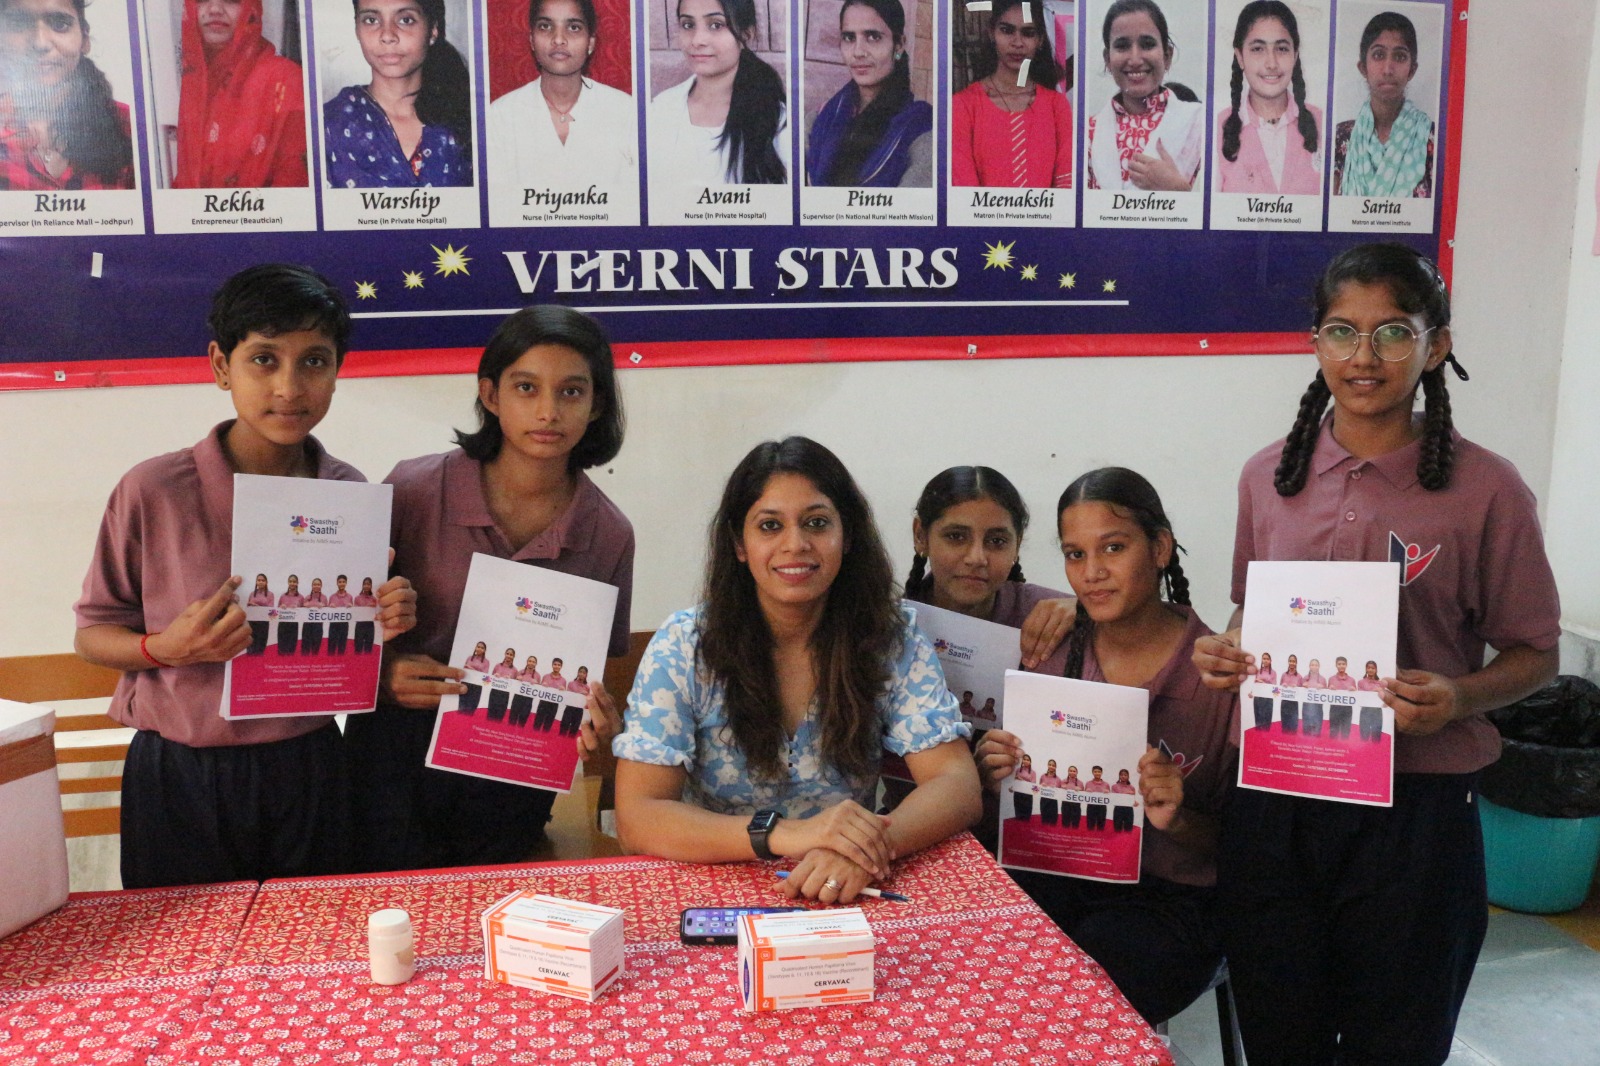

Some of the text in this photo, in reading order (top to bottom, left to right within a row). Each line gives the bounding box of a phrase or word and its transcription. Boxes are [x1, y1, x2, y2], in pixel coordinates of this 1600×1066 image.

[203, 191, 265, 213] Rekha
[522, 185, 608, 213] Priyanka
[697, 187, 751, 205] Avani
[846, 190, 893, 208] Pintu
[971, 189, 1055, 208] Meenakshi
[1112, 193, 1176, 211] Devshree
[34, 193, 87, 212] Rinu
[360, 189, 441, 217] Warship
[1247, 196, 1293, 214] Varsha
[1362, 199, 1401, 215] Sarita
[191, 217, 283, 226] Entrepreneur (Beautician)
[379, 217, 390, 226] (In
[390, 217, 415, 225] Private
[416, 217, 447, 225] Hospital)
[543, 214, 553, 222] (In
[578, 214, 609, 222] Hospital)
[705, 212, 714, 220] (In
[738, 212, 767, 220] Hospital)
[802, 213, 835, 221] Supervisor
[996, 212, 1005, 220] (In
[31, 219, 42, 228] (In
[43, 218, 75, 226] Reliance
[76, 218, 93, 226] Mall
[101, 217, 133, 227] Jodhpur)
[503, 247, 959, 294] VEERNI STARS
[309, 517, 339, 527] Swasthya
[309, 525, 338, 535] Saathi
[533, 601, 562, 613] Swasthya
[1307, 599, 1336, 607] Swasthya
[308, 612, 352, 621] SECURED
[532, 607, 559, 621] Saathi
[1307, 606, 1335, 616] Saathi
[948, 648, 971, 660] Saathi
[519, 686, 564, 703] SECURED
[1307, 692, 1356, 705] SECURED
[1066, 713, 1093, 723] Swasthya
[1066, 720, 1091, 731] Saathi
[1066, 793, 1110, 805] SECURED
[538, 966, 571, 978] CERVAVAC
[814, 978, 851, 987] CERVAVAC
